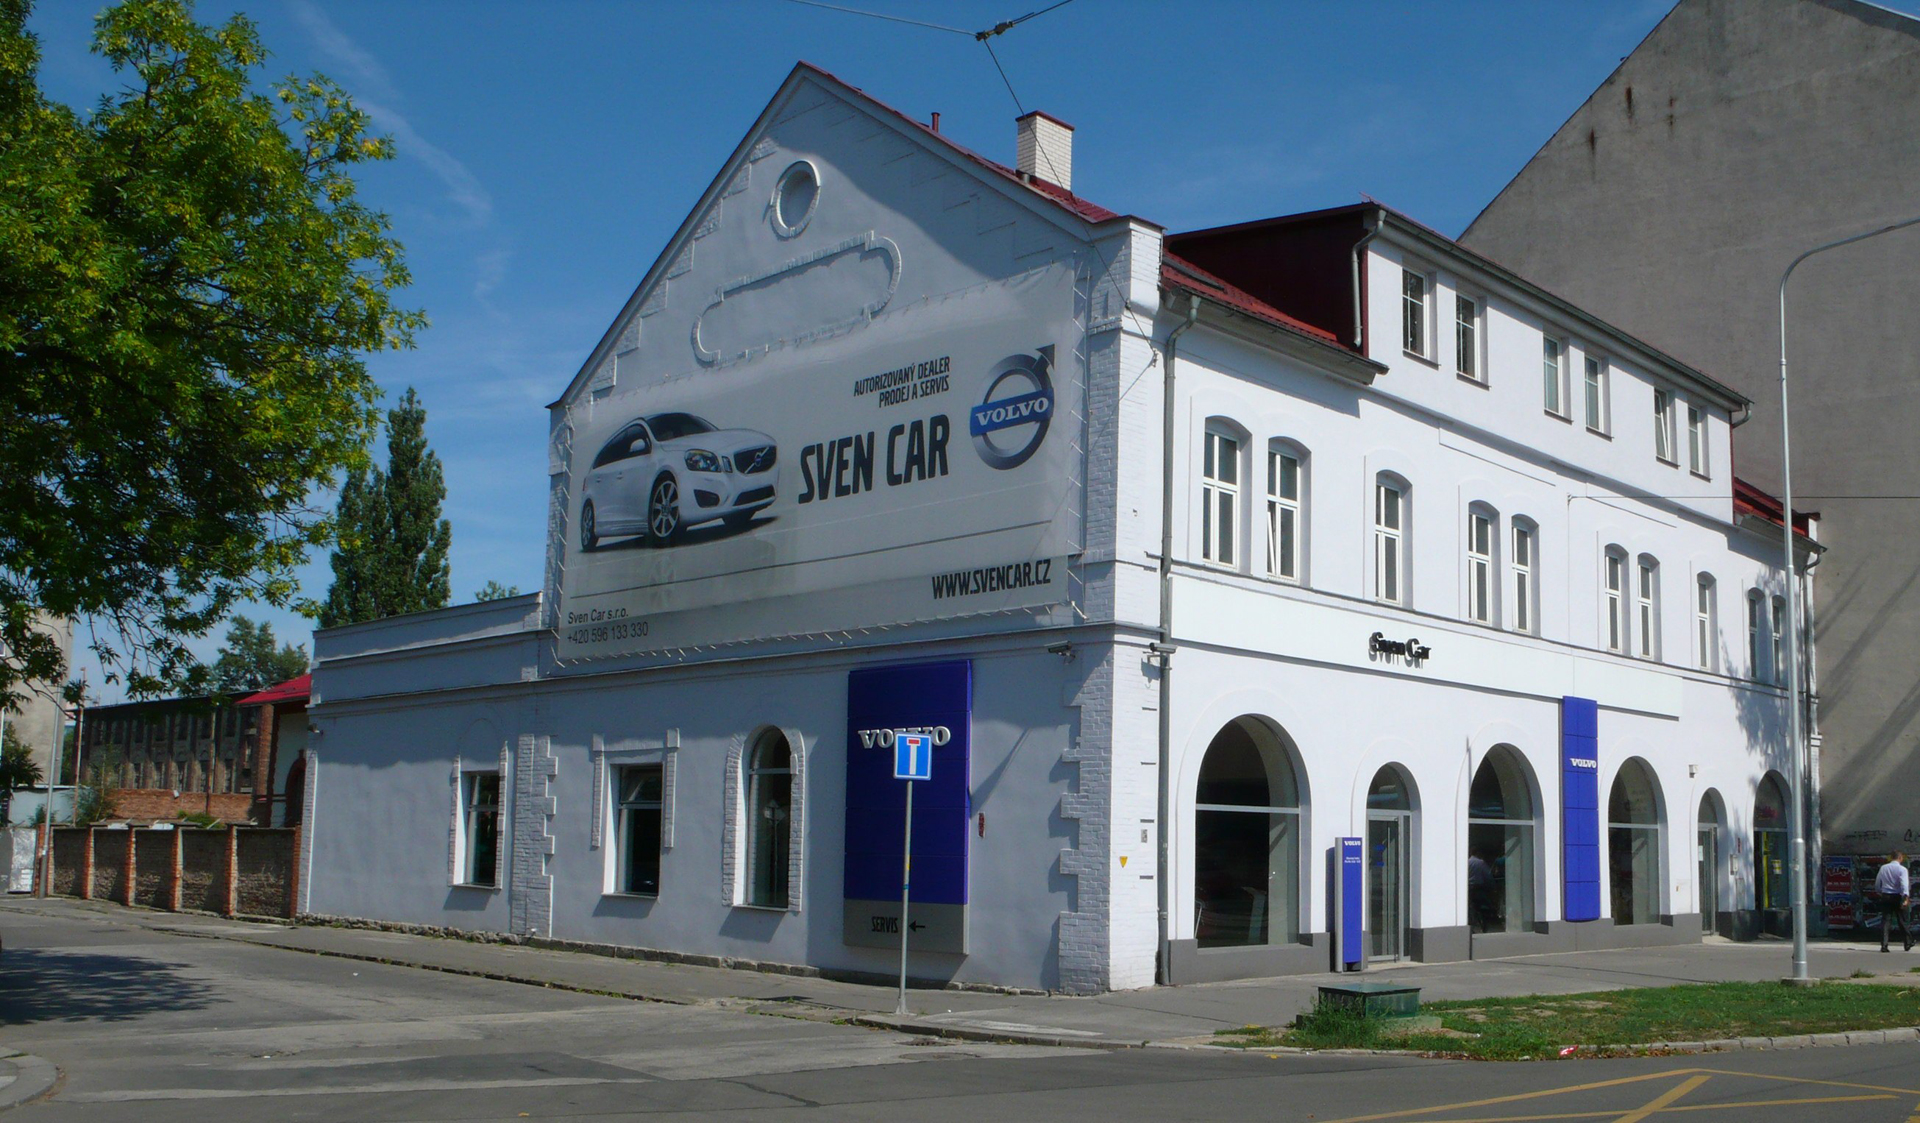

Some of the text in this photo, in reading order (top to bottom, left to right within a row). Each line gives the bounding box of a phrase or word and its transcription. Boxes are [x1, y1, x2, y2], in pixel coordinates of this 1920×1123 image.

[853, 356, 950, 397] AUTORIZOVANÝ DEALER
[879, 375, 950, 408] PRODEJ A SERVIS
[975, 397, 1049, 426] VOLVO
[798, 414, 950, 504] SVEN CAR
[931, 558, 1051, 600] WWW.SVENCAR.CZ
[567, 608, 629, 625] Sven Car s.r.o.
[567, 621, 649, 645] +420 596 133 330
[858, 725, 951, 750] VOO
[1570, 758, 1597, 769] VOLVO
[871, 916, 899, 933] SERVIS
